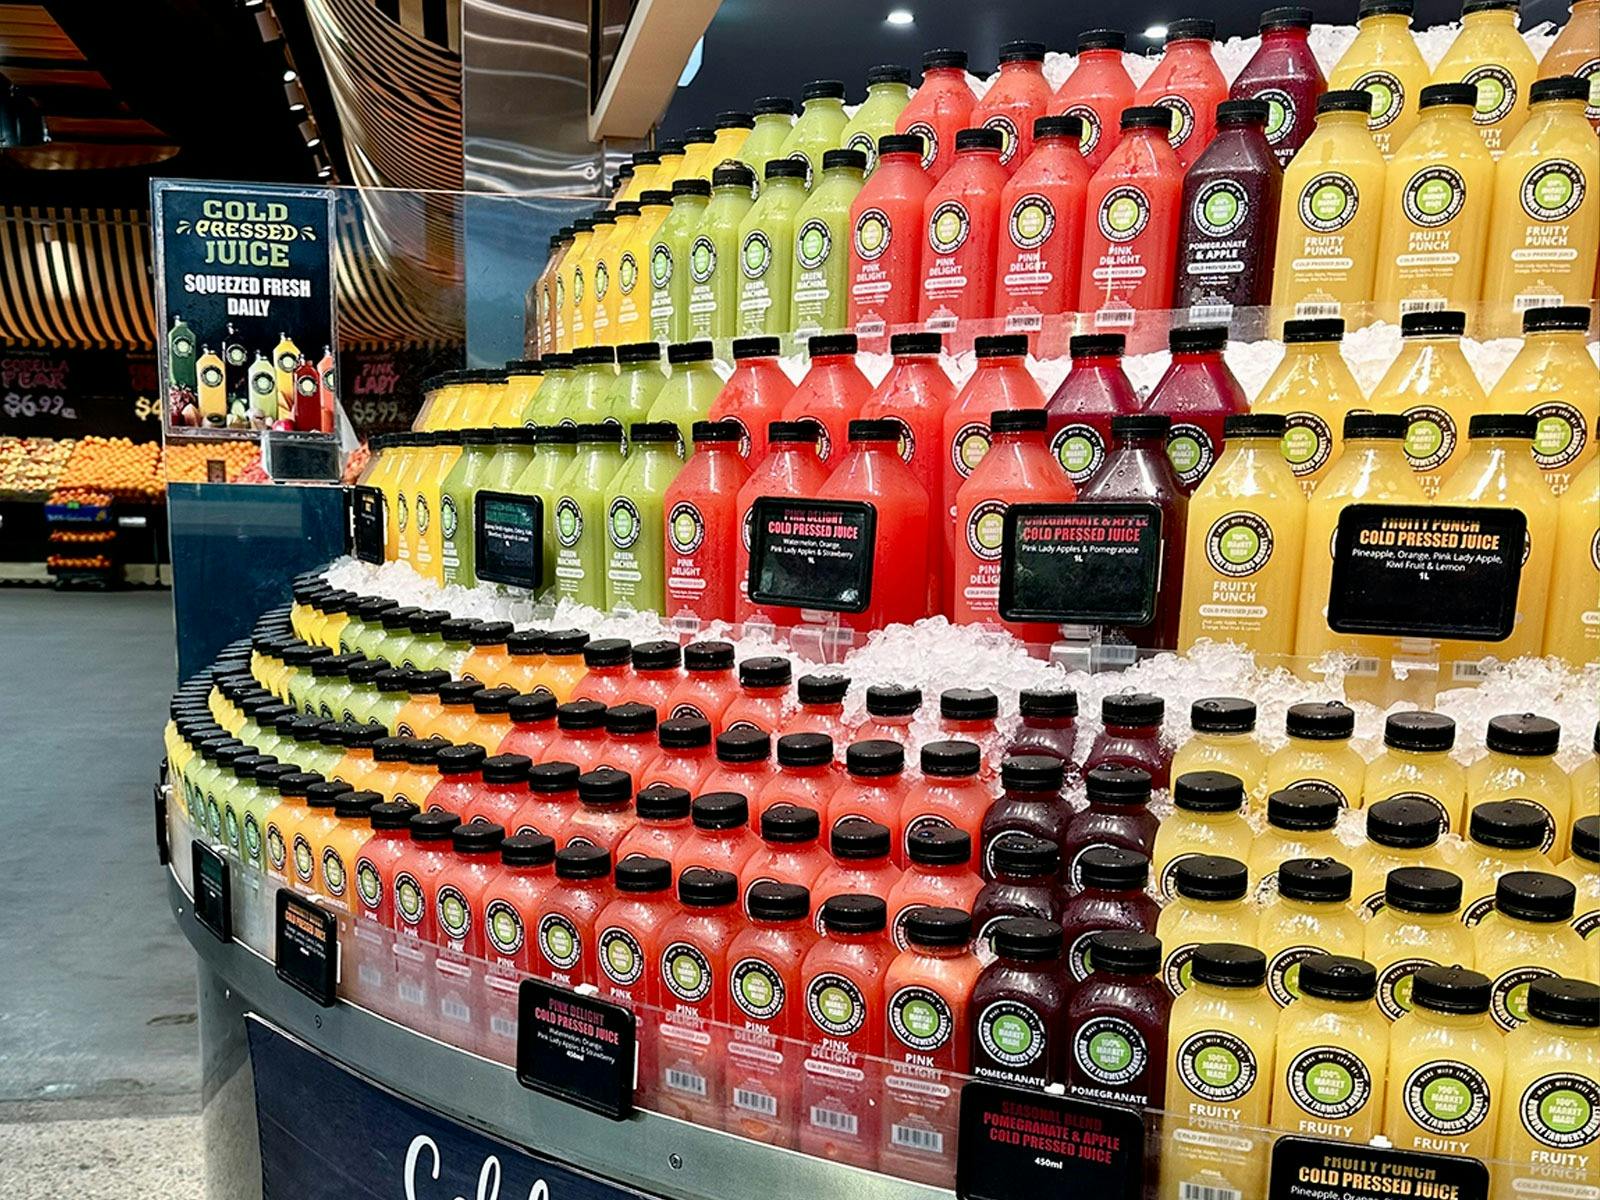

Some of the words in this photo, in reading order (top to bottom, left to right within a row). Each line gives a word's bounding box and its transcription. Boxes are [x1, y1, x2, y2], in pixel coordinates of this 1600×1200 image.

[203, 200, 288, 221] COLD
[195, 220, 298, 241] PRESSED
[1409, 230, 1451, 241] FRUITY
[1526, 225, 1570, 236] FRUITY
[1189, 240, 1247, 250] POMEGRANATE
[1305, 236, 1345, 246] FRUITY
[1409, 241, 1449, 251] PUNCH
[1525, 236, 1568, 246] PUNCH
[205, 240, 289, 267] JUICE
[1108, 245, 1133, 255] PINK
[1206, 249, 1238, 259] APPLE
[1304, 246, 1343, 256] PUNCH
[1099, 255, 1141, 265] DELIGHT
[184, 274, 260, 295] SQUEEZED
[263, 278, 311, 297] FRESH
[227, 298, 270, 317] DAILY
[362, 362, 395, 376] PINK
[2, 371, 66, 389] PEAR
[354, 375, 400, 394] LADY
[768, 521, 791, 534] COLD
[793, 523, 832, 537] PRESSED
[833, 526, 858, 539] JUICE
[1022, 527, 1052, 542] COLD
[1054, 527, 1105, 542] PRESSED
[1108, 527, 1140, 542] JUICE
[1359, 530, 1395, 546] COLD
[1397, 531, 1458, 548] PRESSED
[1460, 534, 1500, 550] JUICE
[784, 547, 796, 555] Lady
[797, 547, 816, 556] Apples
[822, 549, 854, 560] Strawberry
[1022, 544, 1037, 552] Pink
[1038, 545, 1055, 554] Lady
[1056, 544, 1081, 554] Apples
[1082, 545, 1088, 553] &
[1089, 545, 1139, 555] Pomegranate
[1352, 548, 1396, 559] Pineapple,
[1397, 550, 1431, 560] Orange,
[1433, 552, 1451, 560] Pink
[1453, 553, 1475, 564] Lady
[1475, 554, 1503, 564] Apple,
[672, 566, 701, 576] DELIGHT
[1385, 560, 1403, 568] Kiwi
[1405, 561, 1425, 570] Fruit
[1427, 562, 1434, 570] &
[1435, 562, 1465, 572] Lemon
[970, 575, 1000, 584] DELIG
[1419, 572, 1430, 580] 1L
[1213, 581, 1258, 592] FRUITY
[1213, 591, 1256, 602] PUNCH
[551, 971, 570, 984] PINK
[610, 987, 632, 1000] PINK
[549, 998, 569, 1014] PINK
[570, 1004, 604, 1026] DELIGHT
[675, 1004, 699, 1017] PINK
[535, 1007, 556, 1024] COLD
[557, 1013, 594, 1037] PRESSED
[595, 1027, 619, 1045] JUICE
[745, 1021, 769, 1034] PINK
[822, 1038, 849, 1051] PINK
[905, 1053, 934, 1068] PINK
[975, 1067, 1045, 1087] POMEGRANATE
[1071, 1086, 1148, 1104] POMEGRANATE
[1002, 1101, 1061, 1123] SEASONAL
[1064, 1113, 1103, 1131] BLEND
[1189, 1103, 1241, 1120] FRUITY
[983, 1112, 1069, 1140] POMEGRANATE
[1072, 1131, 1080, 1143] &
[1083, 1132, 1120, 1151] APPLE
[1299, 1120, 1353, 1137] FRUITY
[990, 1127, 1020, 1145] COLD
[1022, 1134, 1075, 1156] PRESSED
[1078, 1145, 1112, 1164] JUICE
[1413, 1136, 1470, 1153] FRUITY
[1034, 1157, 1063, 1169] 450ml
[1531, 1150, 1589, 1168] FRUITY
[1380, 1163, 1437, 1181] PUNCH
[1531, 1163, 1587, 1180] PUNCH
[1298, 1166, 1339, 1186] COLD
[1342, 1172, 1412, 1196] PRESSED
[1414, 1181, 1460, 1200] JUICE
[1290, 1185, 1340, 1200] Pineapple,
